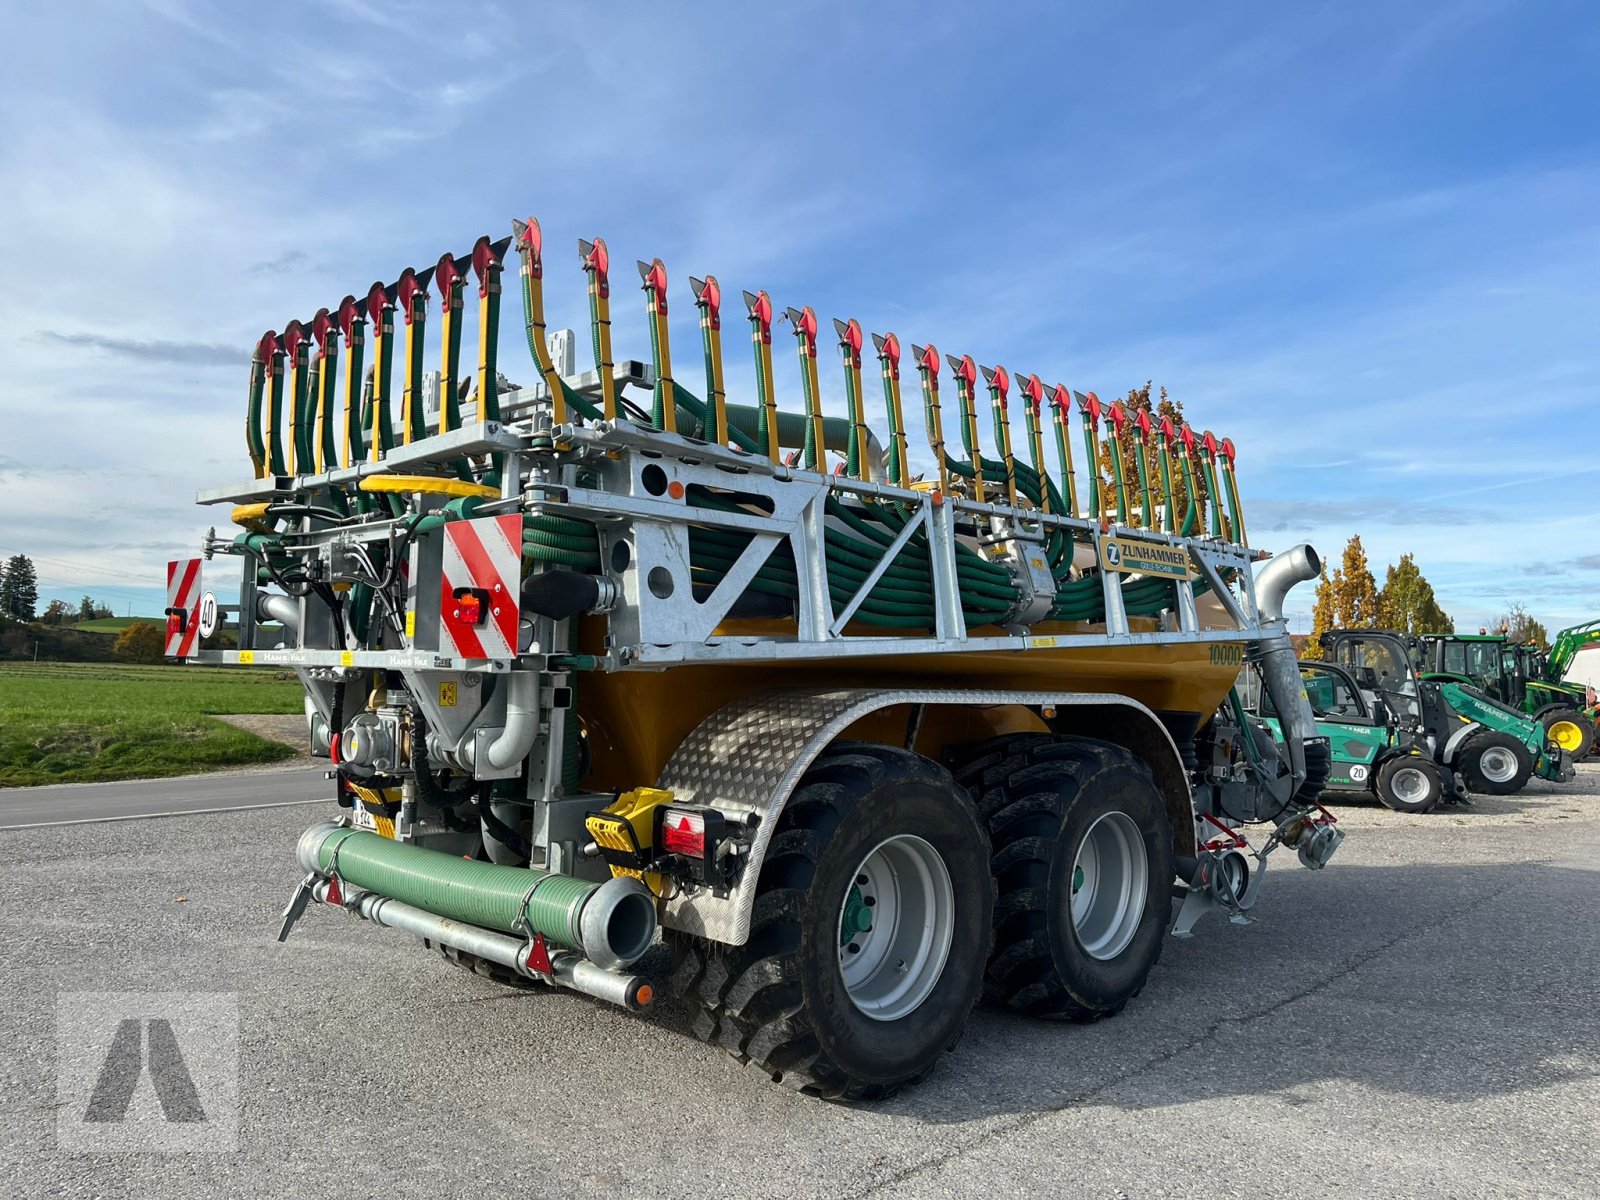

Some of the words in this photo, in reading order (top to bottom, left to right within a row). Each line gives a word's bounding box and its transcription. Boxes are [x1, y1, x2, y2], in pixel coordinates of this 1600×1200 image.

[1121, 544, 1185, 565] ZUNHAMMER
[201, 599, 214, 628] 40
[1209, 643, 1241, 666] 10000
[1474, 701, 1510, 722] KRAMER
[1353, 767, 1364, 779] 20
